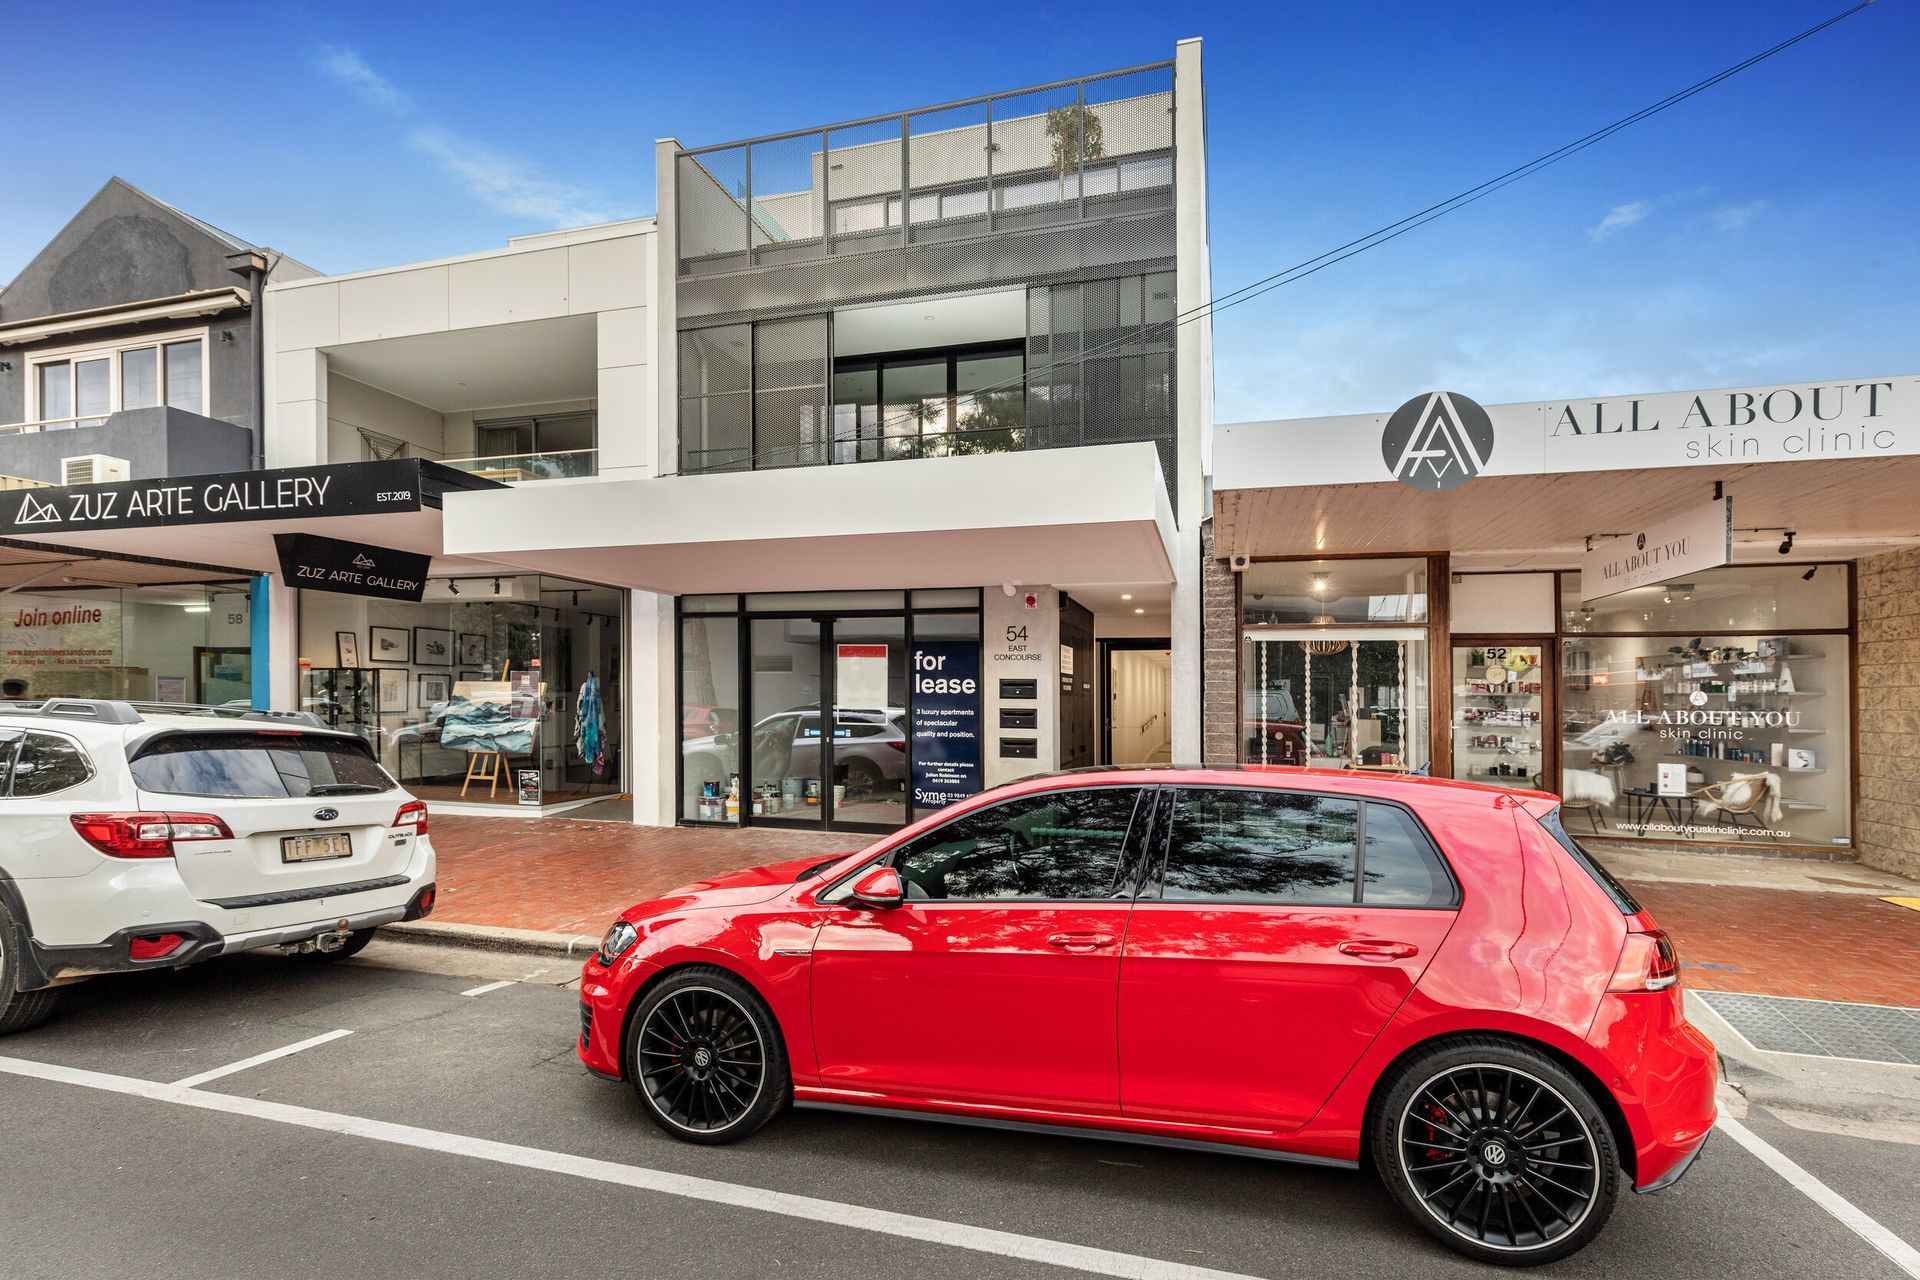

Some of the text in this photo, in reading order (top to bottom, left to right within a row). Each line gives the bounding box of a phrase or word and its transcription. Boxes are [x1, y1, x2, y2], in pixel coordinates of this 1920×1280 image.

[1549, 382, 1892, 437] ALL ABOUT
[1686, 425, 1895, 459] skin clinic
[69, 476, 331, 521] ZUZ ARTE GALLERY
[1602, 562, 1621, 580] ALL
[1622, 548, 1661, 573] ABOUT
[1665, 537, 1692, 560] YOU
[297, 565, 419, 591] ZUZ ARTE GALLERY
[1641, 569, 1661, 582] clinic
[14, 605, 102, 628] Join online
[227, 613, 243, 625] 58
[1006, 625, 1028, 642] 54
[914, 650, 947, 671] for
[994, 653, 1043, 661] CONCOURSE
[1486, 648, 1507, 660] 52
[915, 673, 976, 694] lease
[921, 708, 940, 716] luxury
[1605, 709, 1802, 727] ALL ABOUT YOU
[1659, 727, 1743, 740] skin clinic
[915, 787, 947, 804] Syme
[925, 797, 946, 805] Property
[1616, 822, 1791, 838] www.allaboutyouskinclinic.com.au
